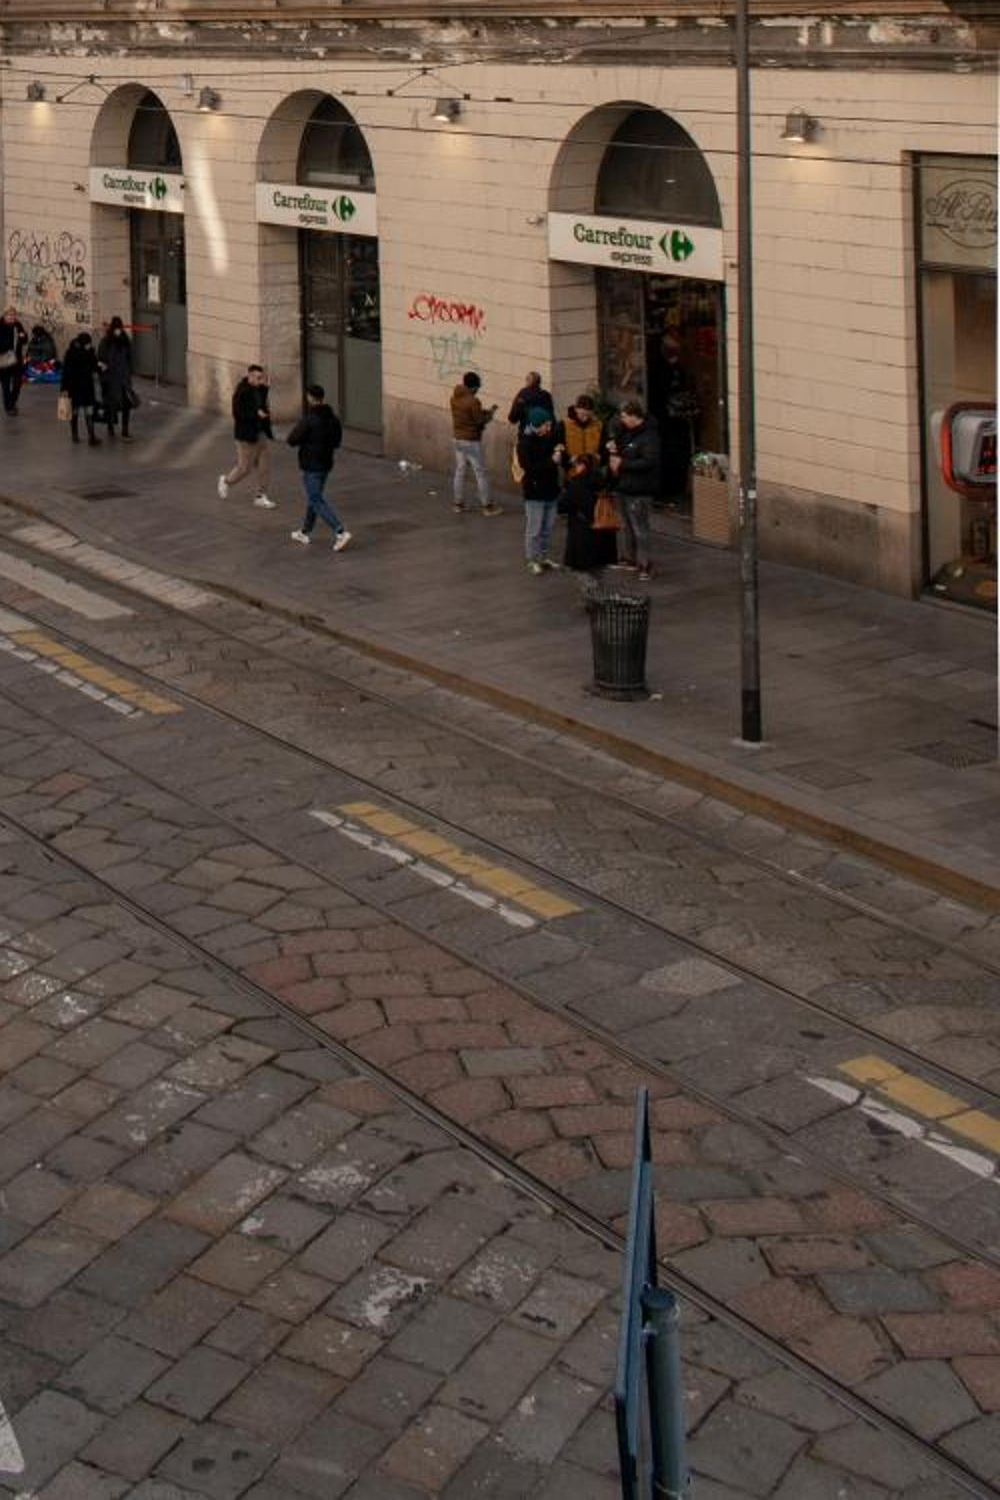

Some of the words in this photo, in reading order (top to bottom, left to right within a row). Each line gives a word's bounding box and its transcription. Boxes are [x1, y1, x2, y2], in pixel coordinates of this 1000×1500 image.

[273, 191, 328, 212] Carrefour
[573, 223, 654, 250] Carrefour
[610, 251, 653, 265] express
